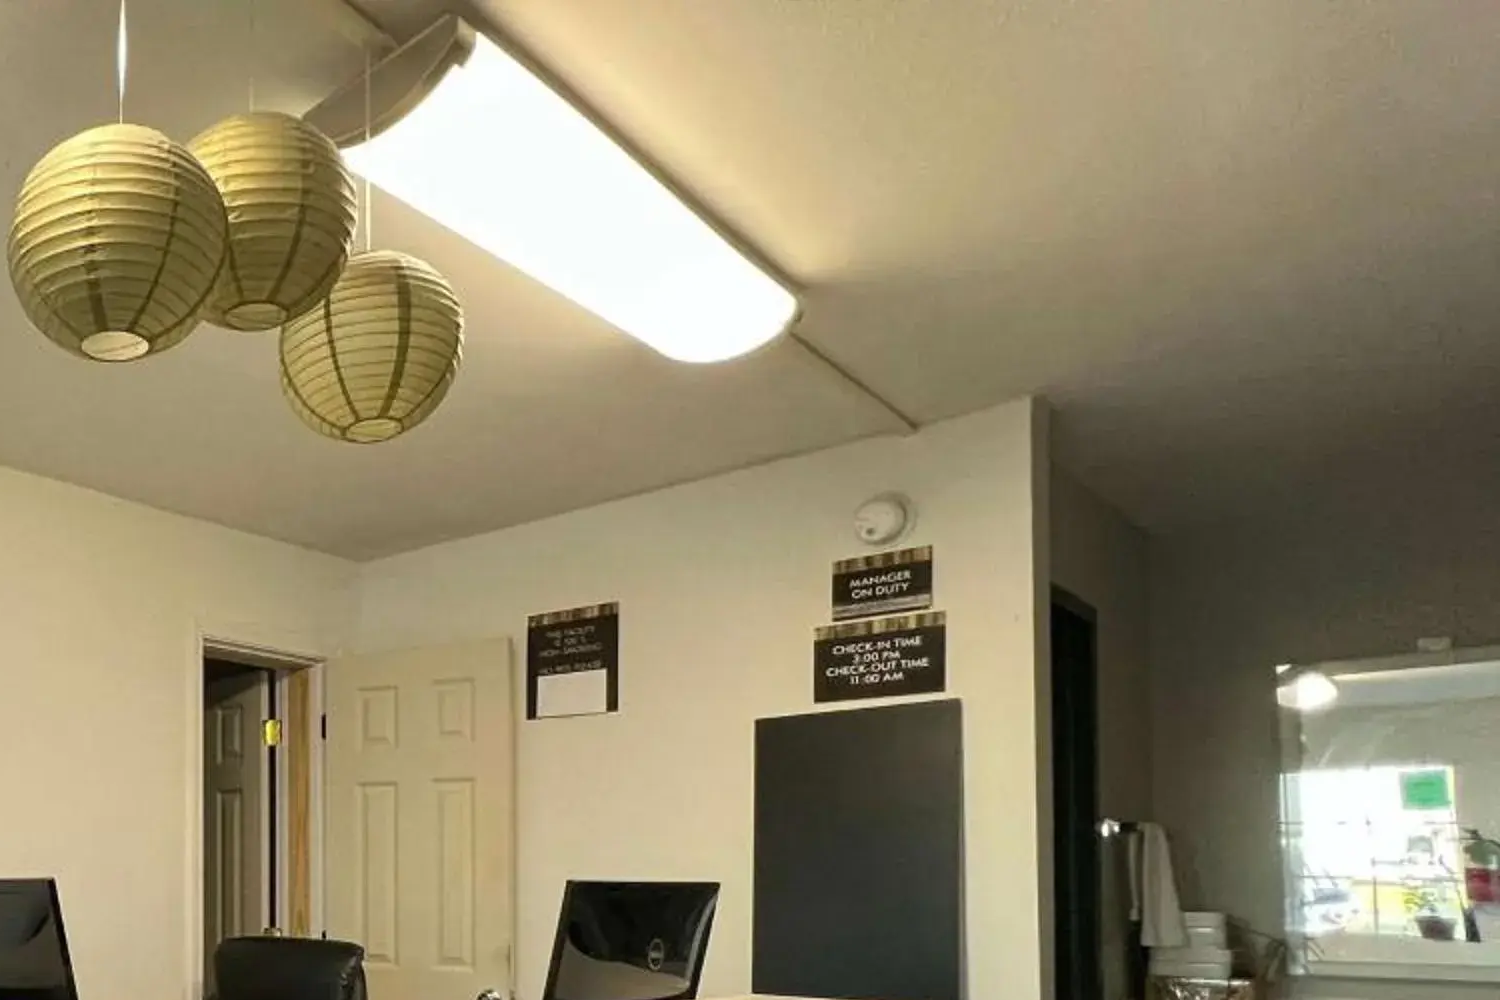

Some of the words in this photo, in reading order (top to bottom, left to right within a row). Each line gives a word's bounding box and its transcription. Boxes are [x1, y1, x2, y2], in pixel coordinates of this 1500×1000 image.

[849, 570, 911, 588] MANAGER
[851, 588, 873, 599] ON
[875, 582, 910, 595] DUTY
[894, 635, 922, 648] TIME
[882, 651, 901, 661] PM
[901, 656, 929, 669] TIME
[883, 671, 905, 682] AM
